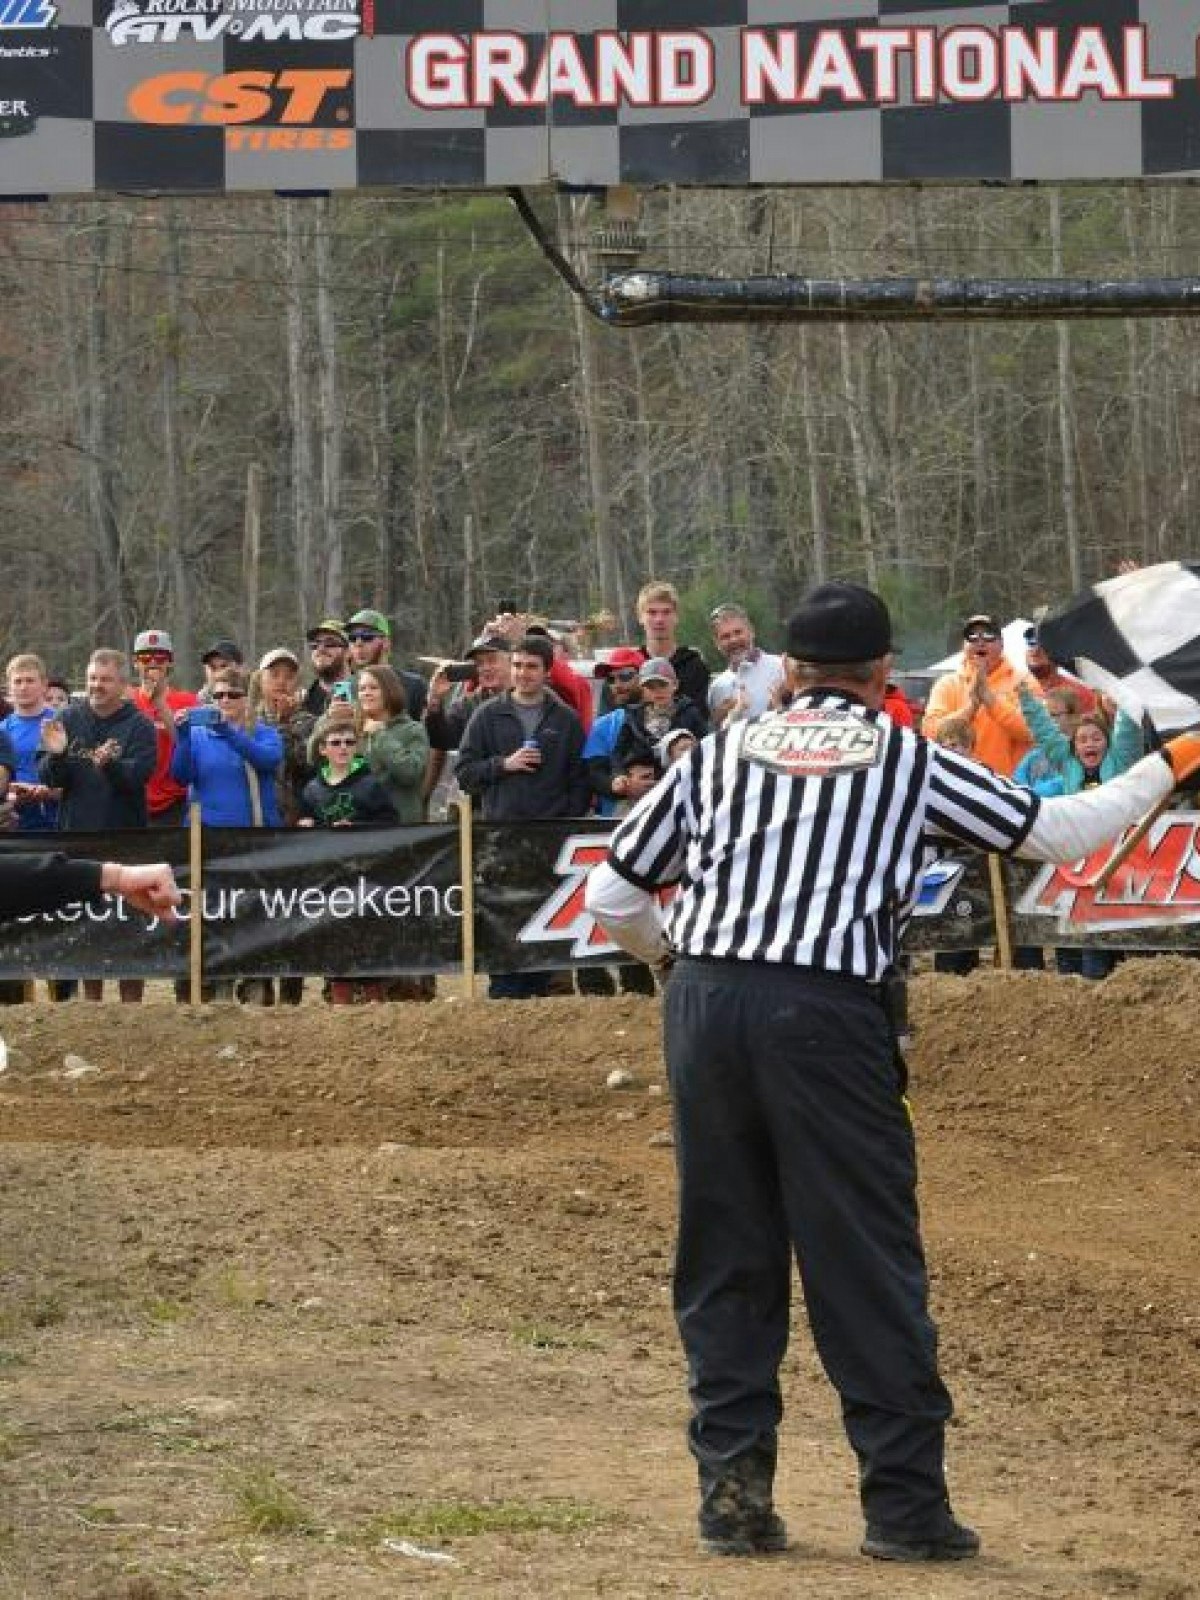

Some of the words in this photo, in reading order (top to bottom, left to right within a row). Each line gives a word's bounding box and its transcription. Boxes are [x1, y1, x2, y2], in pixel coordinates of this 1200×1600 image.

[406, 29, 716, 108] GRAND
[741, 23, 1177, 103] NATIONAL
[127, 69, 352, 124] CST
[227, 129, 351, 149] TIRES
